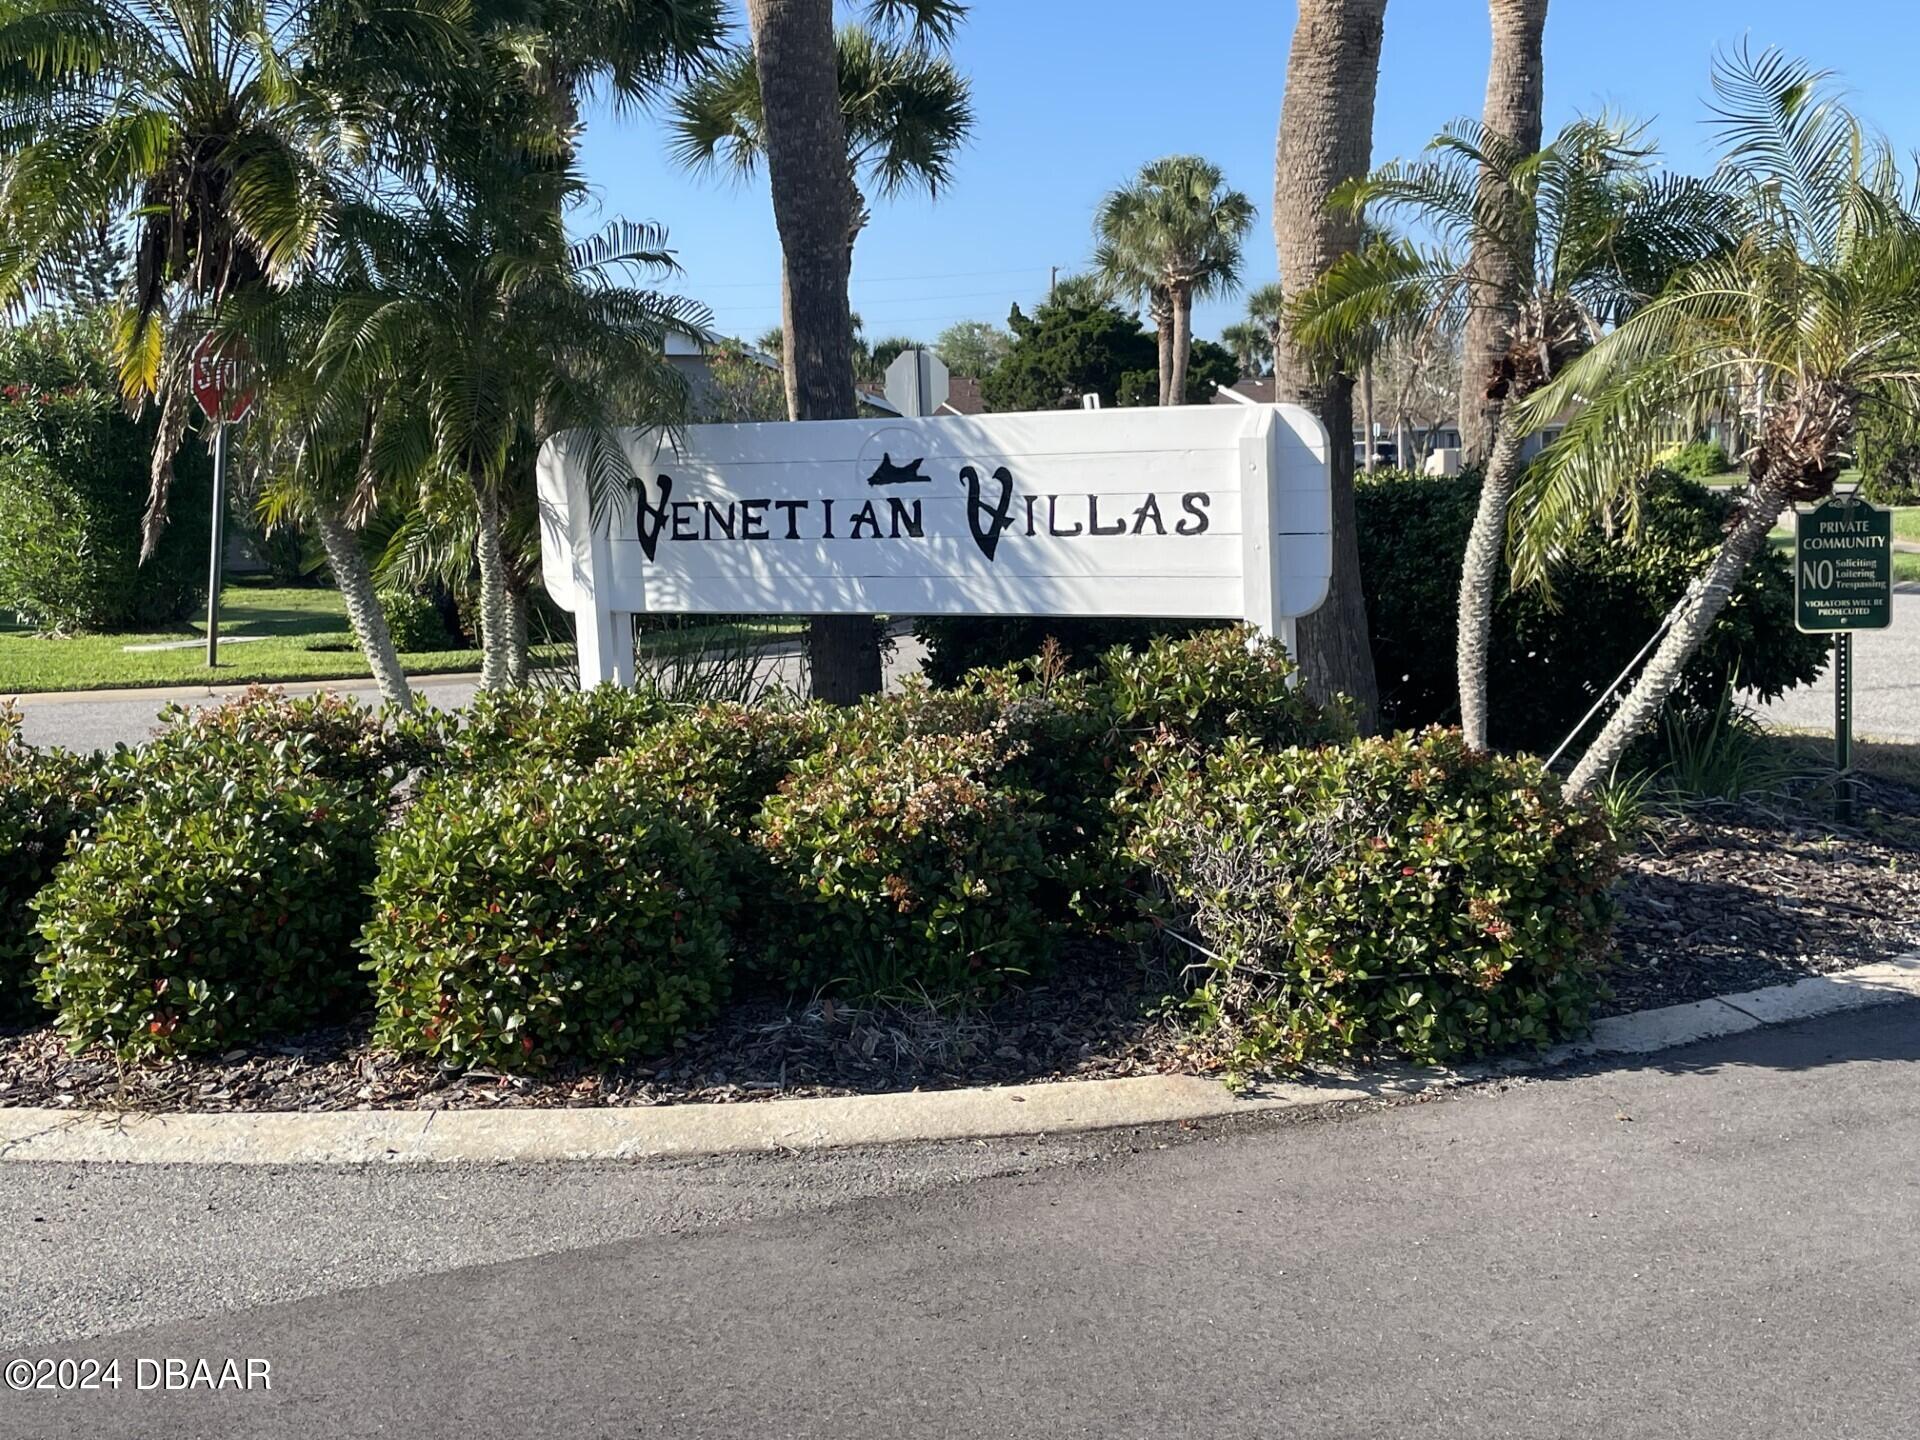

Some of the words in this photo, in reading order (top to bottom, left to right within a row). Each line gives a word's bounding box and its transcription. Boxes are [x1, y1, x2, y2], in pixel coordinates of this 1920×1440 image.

[959, 465, 1211, 562] VILLAS
[1819, 520, 1870, 533] PRIVATE
[1803, 536, 1886, 550] COMMUNITY
[1835, 559, 1877, 568] Soliciting
[1803, 559, 1834, 590] NO
[1835, 568, 1875, 578] Loitering
[1835, 580, 1887, 590] Trespassing
[1805, 600, 1850, 608] VIOLATORS
[1818, 607, 1870, 616] PROSECUTED
